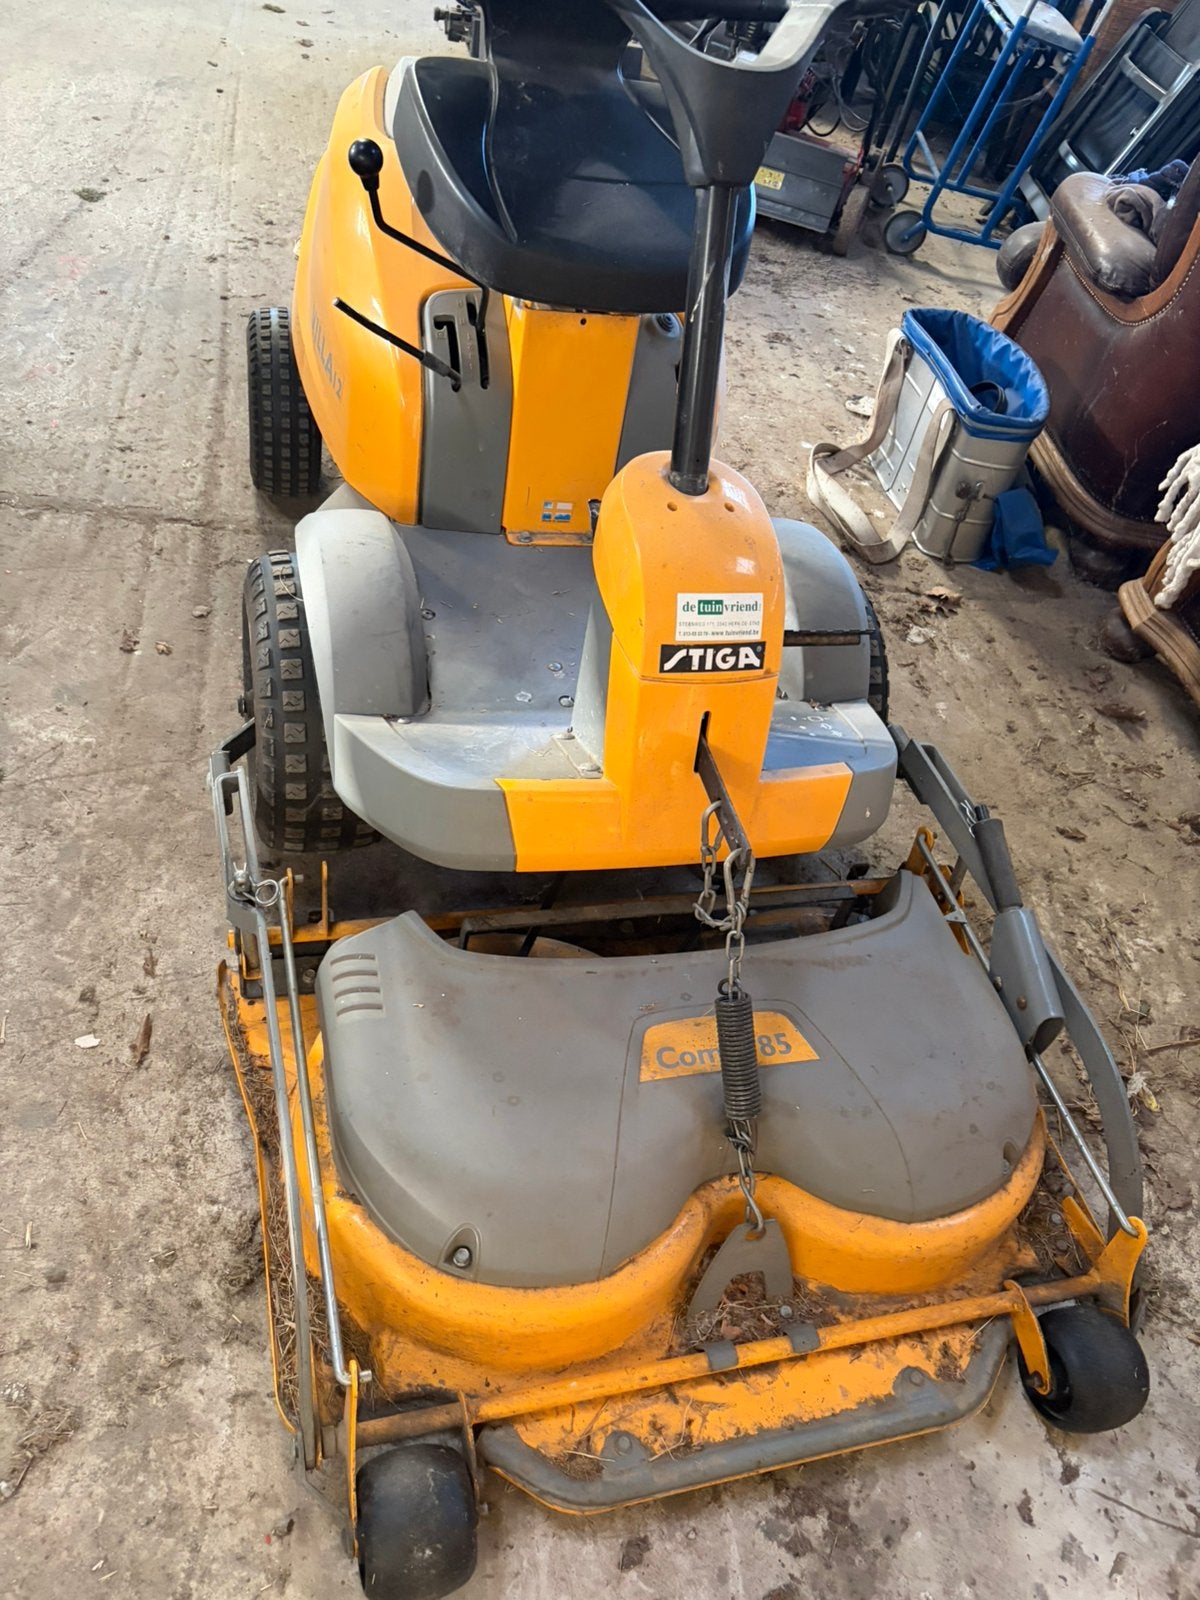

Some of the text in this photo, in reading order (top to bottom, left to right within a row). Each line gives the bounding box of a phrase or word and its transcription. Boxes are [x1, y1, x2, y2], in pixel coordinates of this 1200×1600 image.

[682, 601, 697, 613] de
[663, 646, 761, 671] STIGA
[757, 1032, 793, 1057] 85
